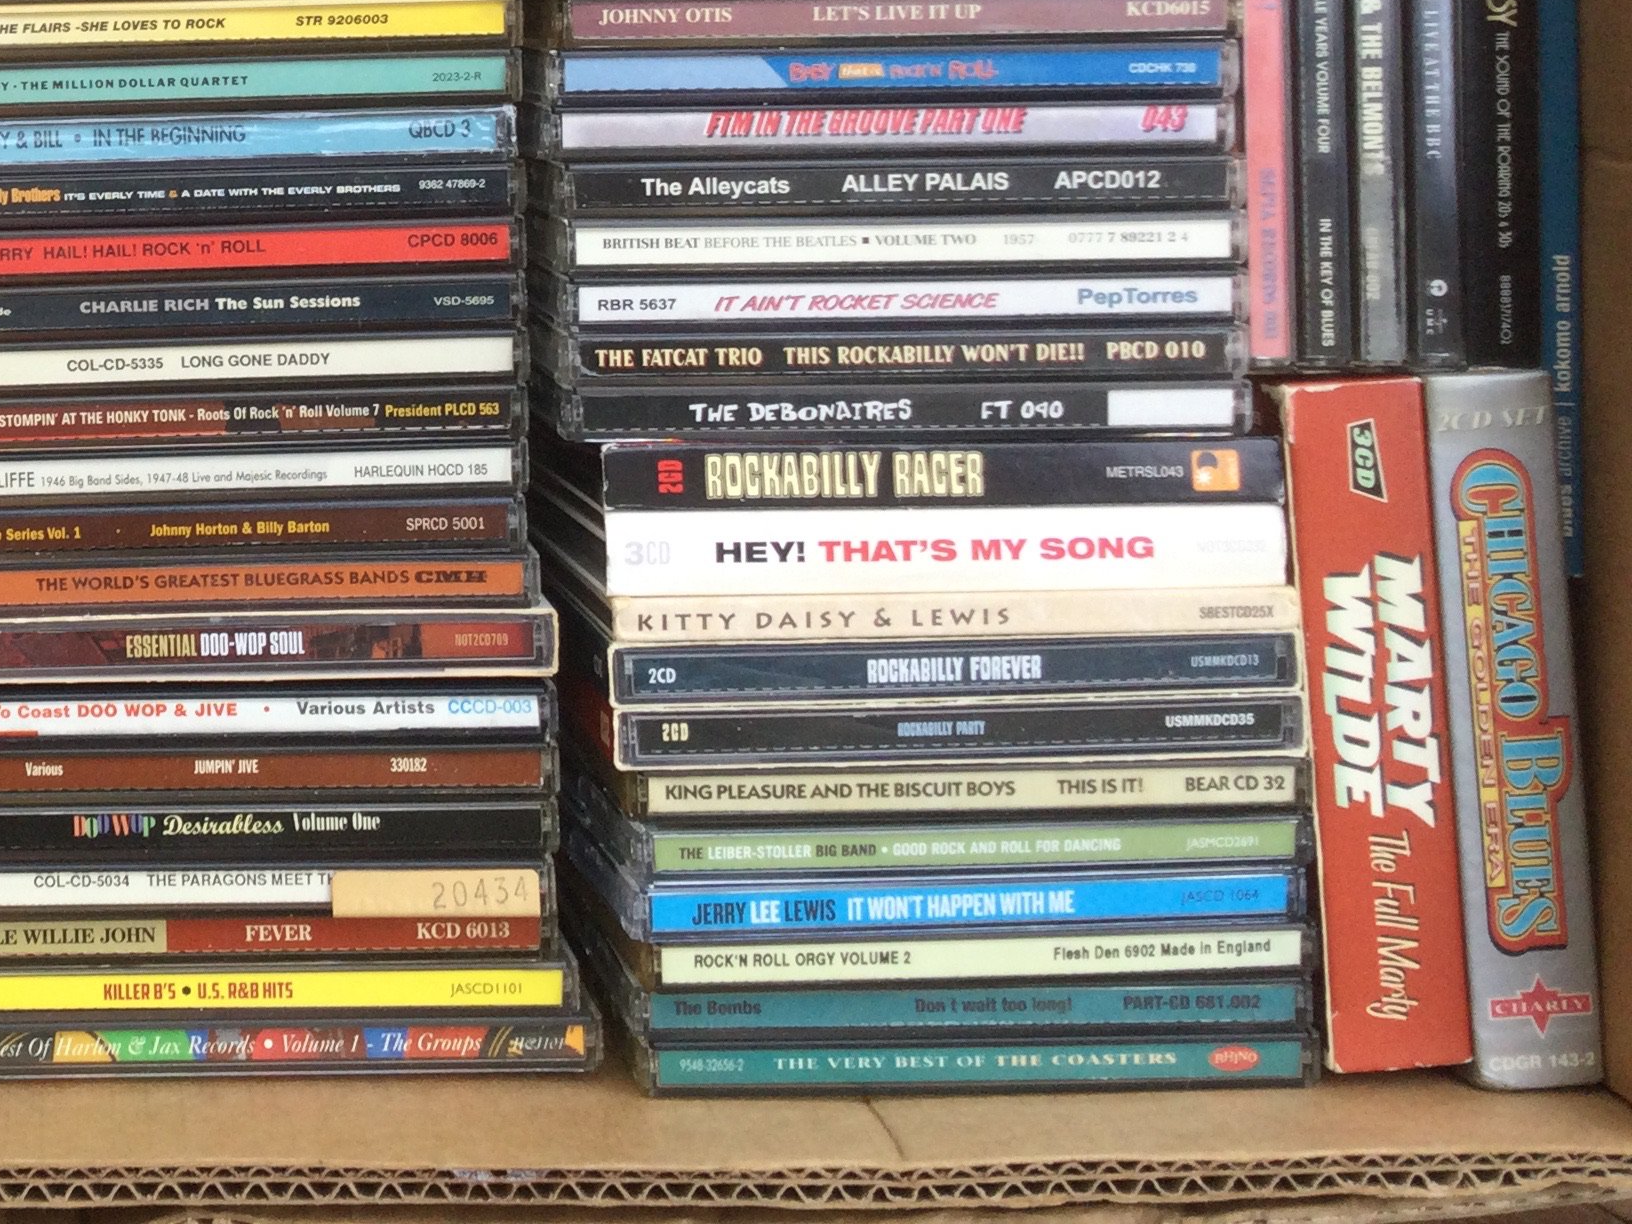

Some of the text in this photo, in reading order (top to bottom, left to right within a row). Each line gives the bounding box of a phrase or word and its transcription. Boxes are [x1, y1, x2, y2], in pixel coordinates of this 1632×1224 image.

[641, 177, 790, 199] The Alleycats
[842, 172, 1009, 192] ALLEY PALAIS
[1054, 170, 1161, 189] APCD012
[1320, 219, 1335, 346] IN THE KEY OF BLUES
[1078, 288, 1198, 308] PepTorres
[1552, 255, 1571, 392] kokomo arnold
[1352, 423, 1377, 491] 3CD
[705, 451, 984, 499] ROCKABILLY RACER
[716, 536, 1153, 563] HEY! THAT'S MY SONG
[638, 608, 1009, 631] KITTY DAISY & LEWIS
[126, 631, 305, 657] ESSENTIAL DOO-WOP SOUL
[867, 655, 1041, 683] ROCKABILLY FOREVER
[1323, 553, 1445, 827] MARTY WILDE
[1459, 463, 1567, 940] CHICAGO BLUES
[18, 706, 69, 718] Coast
[78, 704, 117, 717] DOO
[125, 704, 166, 716] WOP
[175, 704, 186, 716] &
[195, 703, 236, 716] JIVE
[666, 781, 1015, 800] KING PLEASURE AND THE BISCUIT BOYS
[246, 925, 312, 941] FEVER
[417, 922, 509, 939] KCD 6013
[1368, 829, 1420, 1020] The Full Marty
[1495, 995, 1590, 1014] CHARLY
[1212, 1048, 1258, 1070] RHINO
